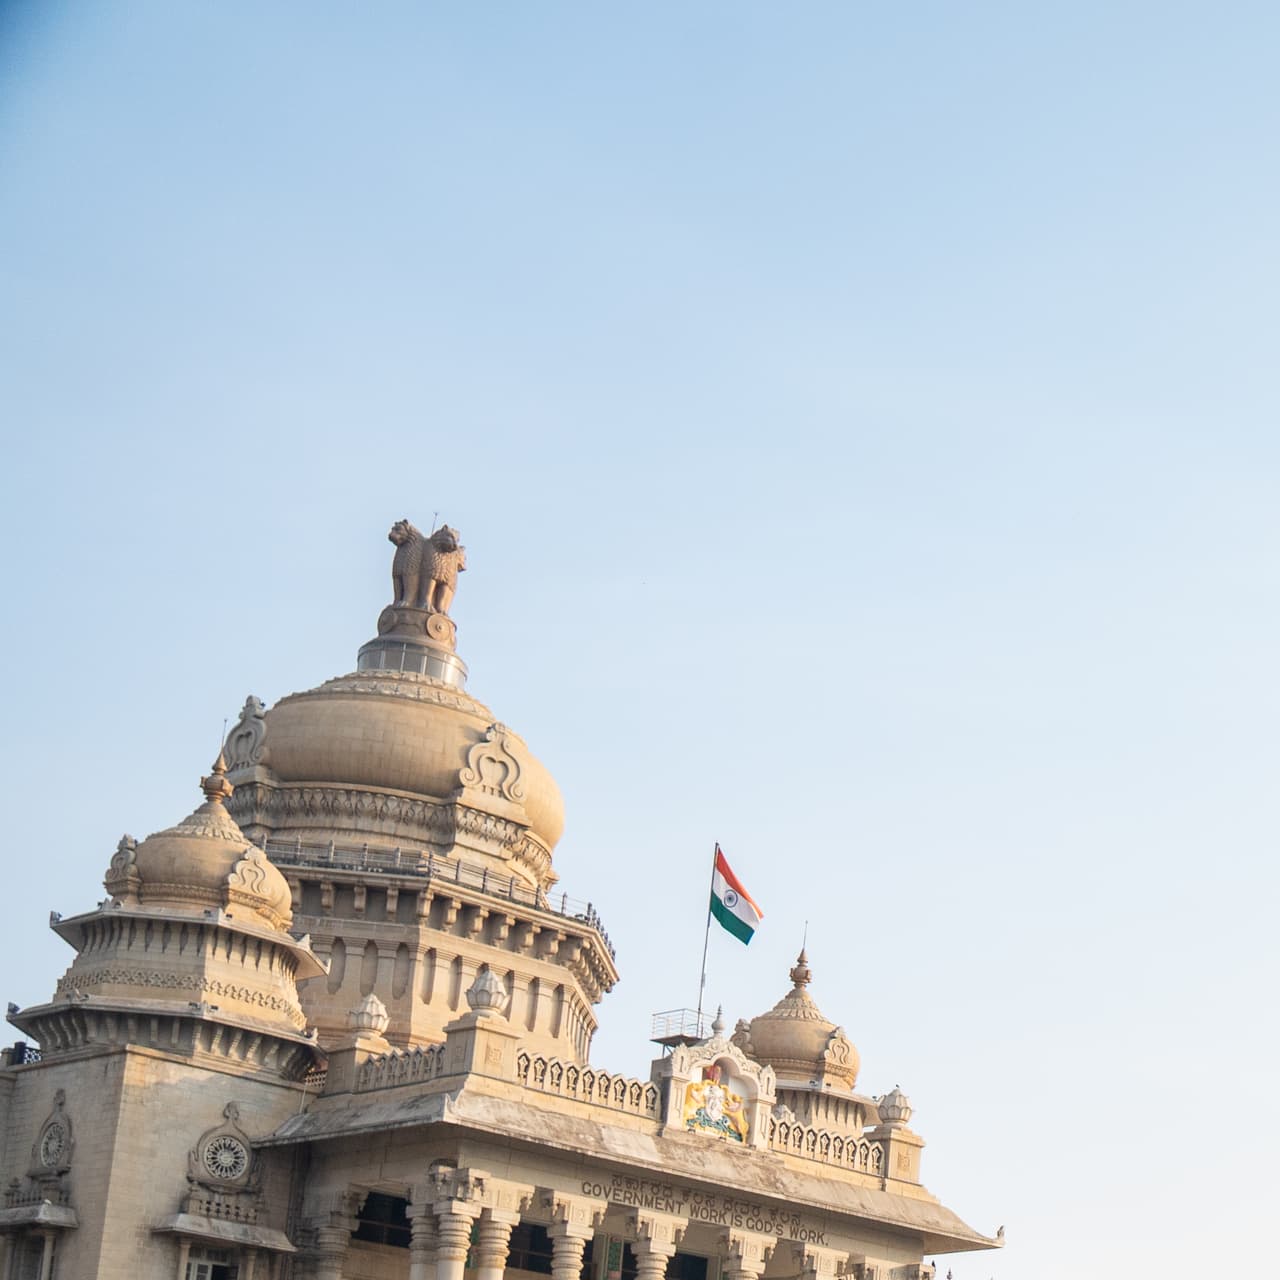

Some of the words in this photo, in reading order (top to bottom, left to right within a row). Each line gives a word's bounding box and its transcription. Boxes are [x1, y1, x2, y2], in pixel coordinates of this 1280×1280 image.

[582, 1181, 685, 1215] GOVERNMENT
[690, 1203, 728, 1225] WORK
[730, 1214, 743, 1228] IS
[745, 1217, 784, 1236] GOD'S
[789, 1225, 829, 1246] WORK.
